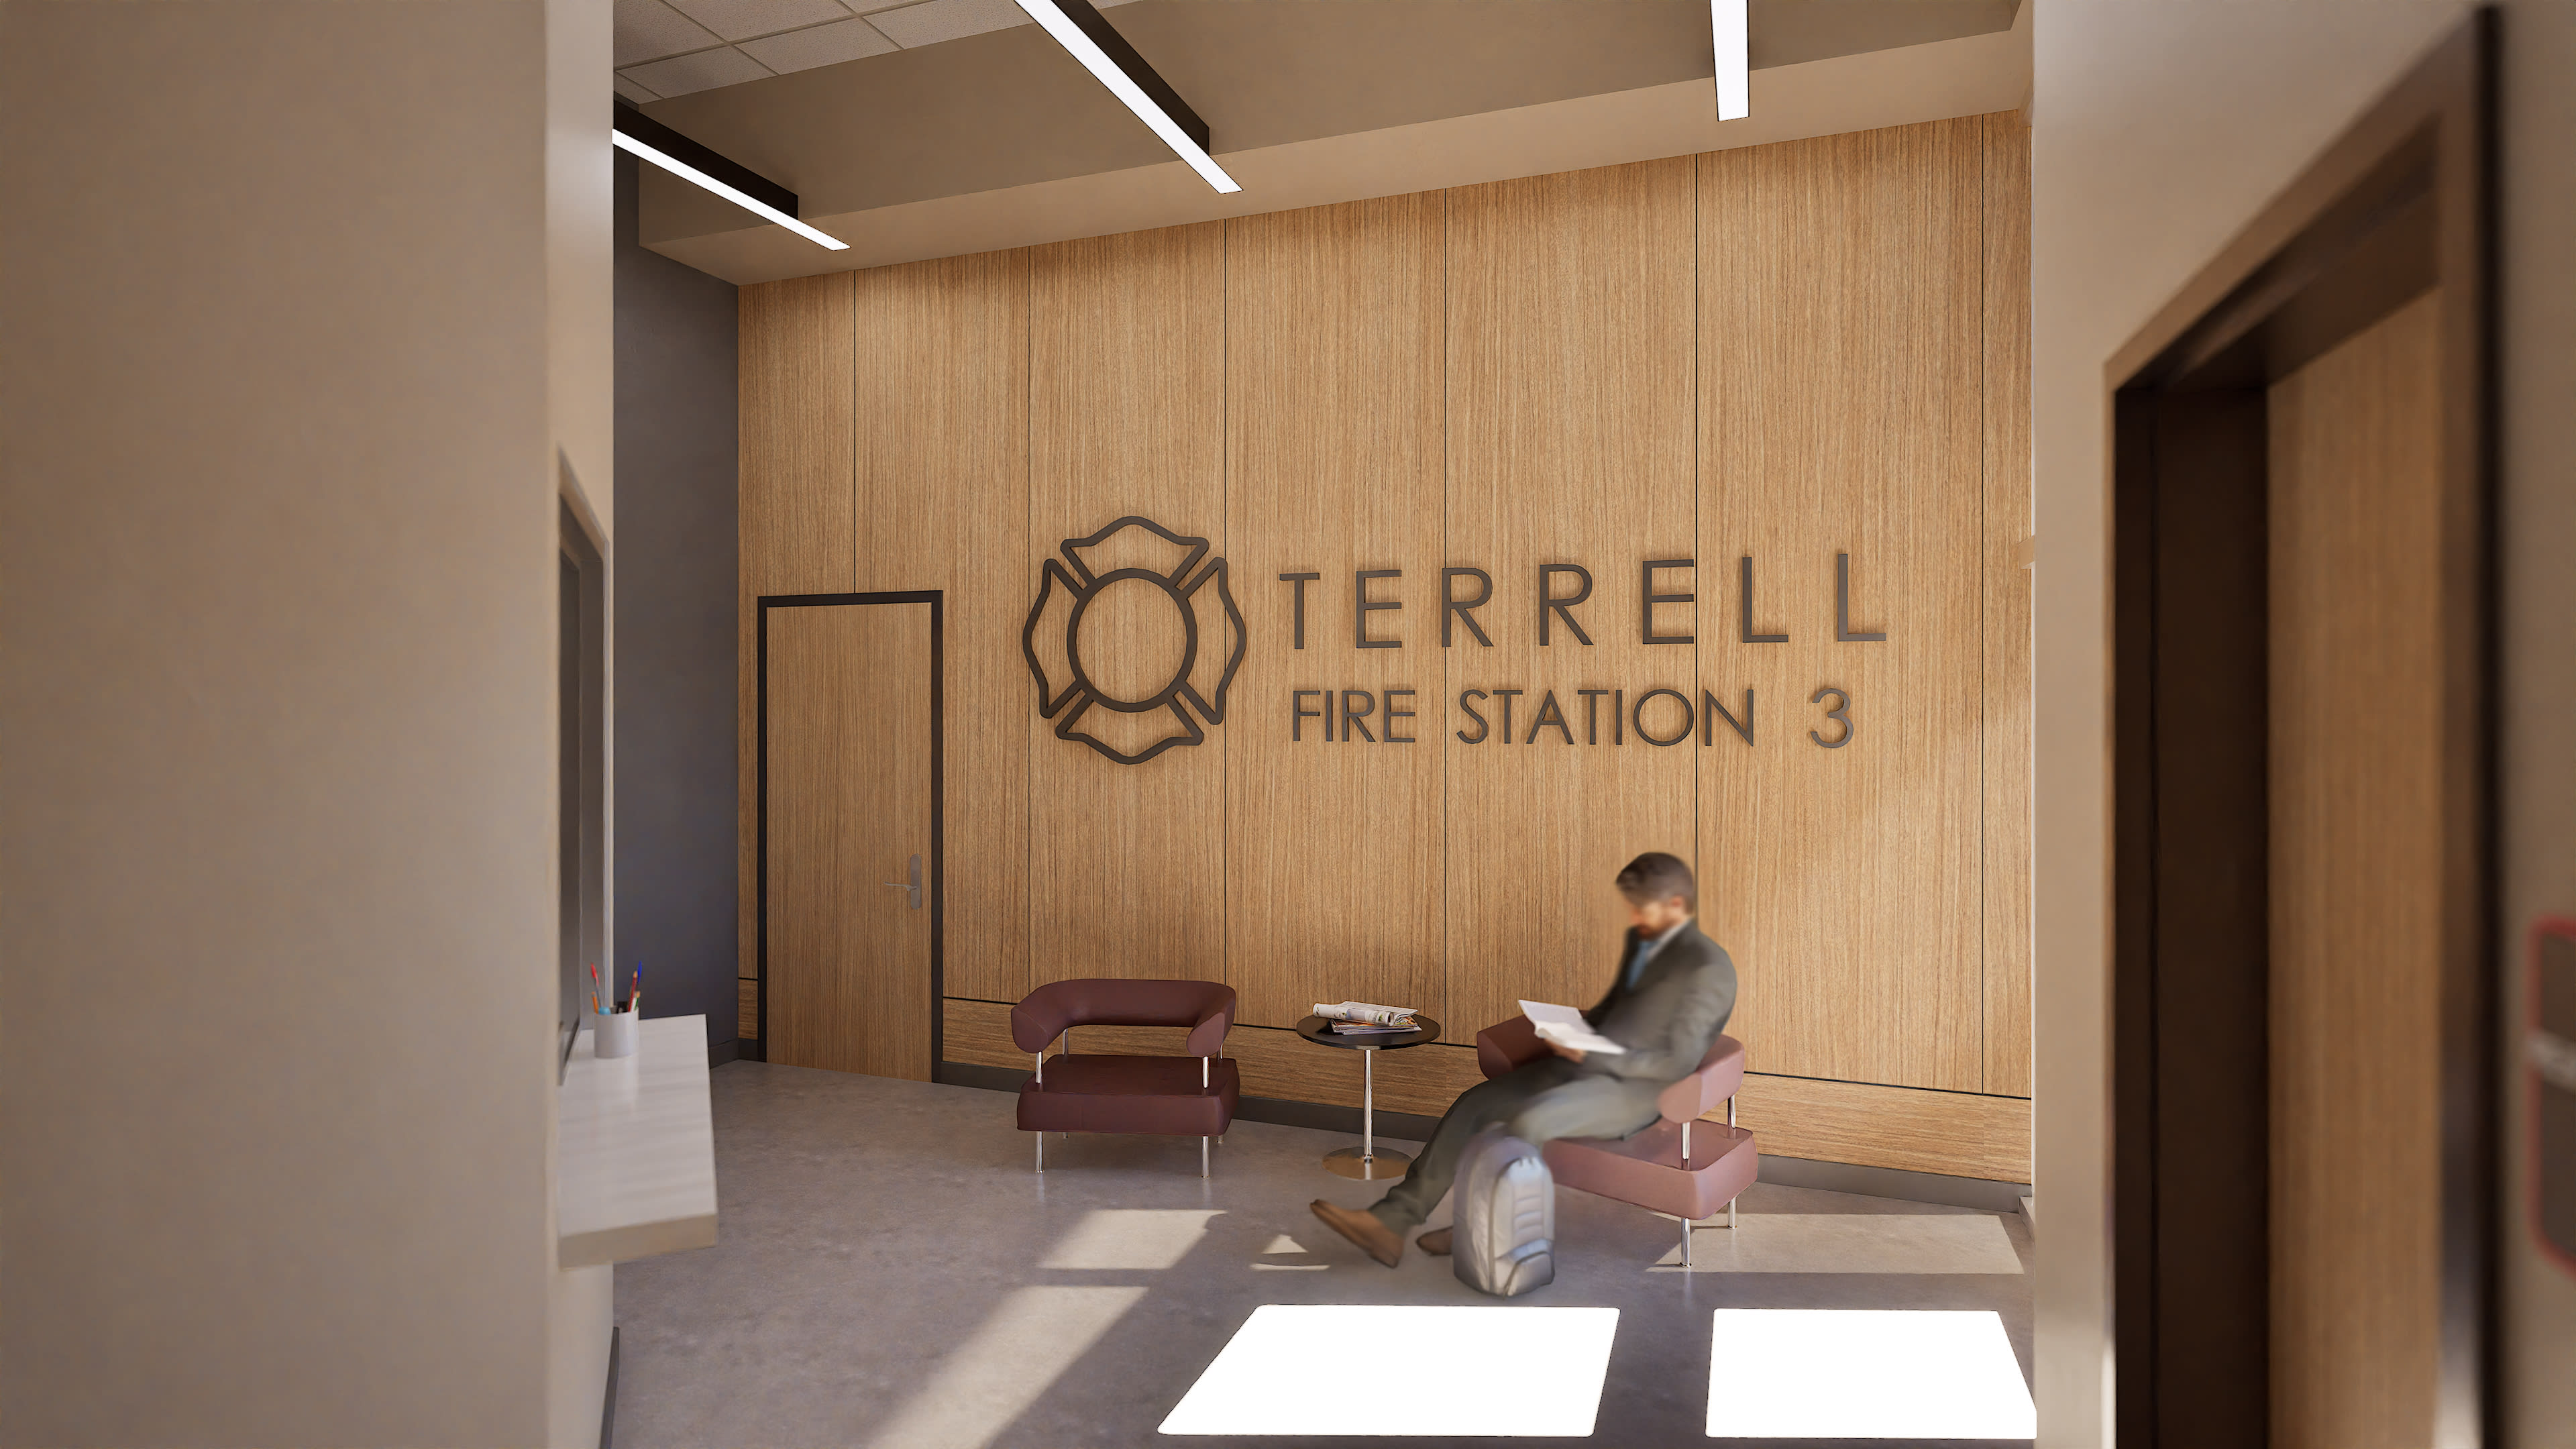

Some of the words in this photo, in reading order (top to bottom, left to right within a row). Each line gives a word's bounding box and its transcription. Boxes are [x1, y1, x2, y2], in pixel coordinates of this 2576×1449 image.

[1279, 553, 1887, 650] TERRELL
[1292, 690, 1416, 743] FIRE
[1456, 688, 1754, 747] STATION
[1811, 688, 1854, 749] 3
